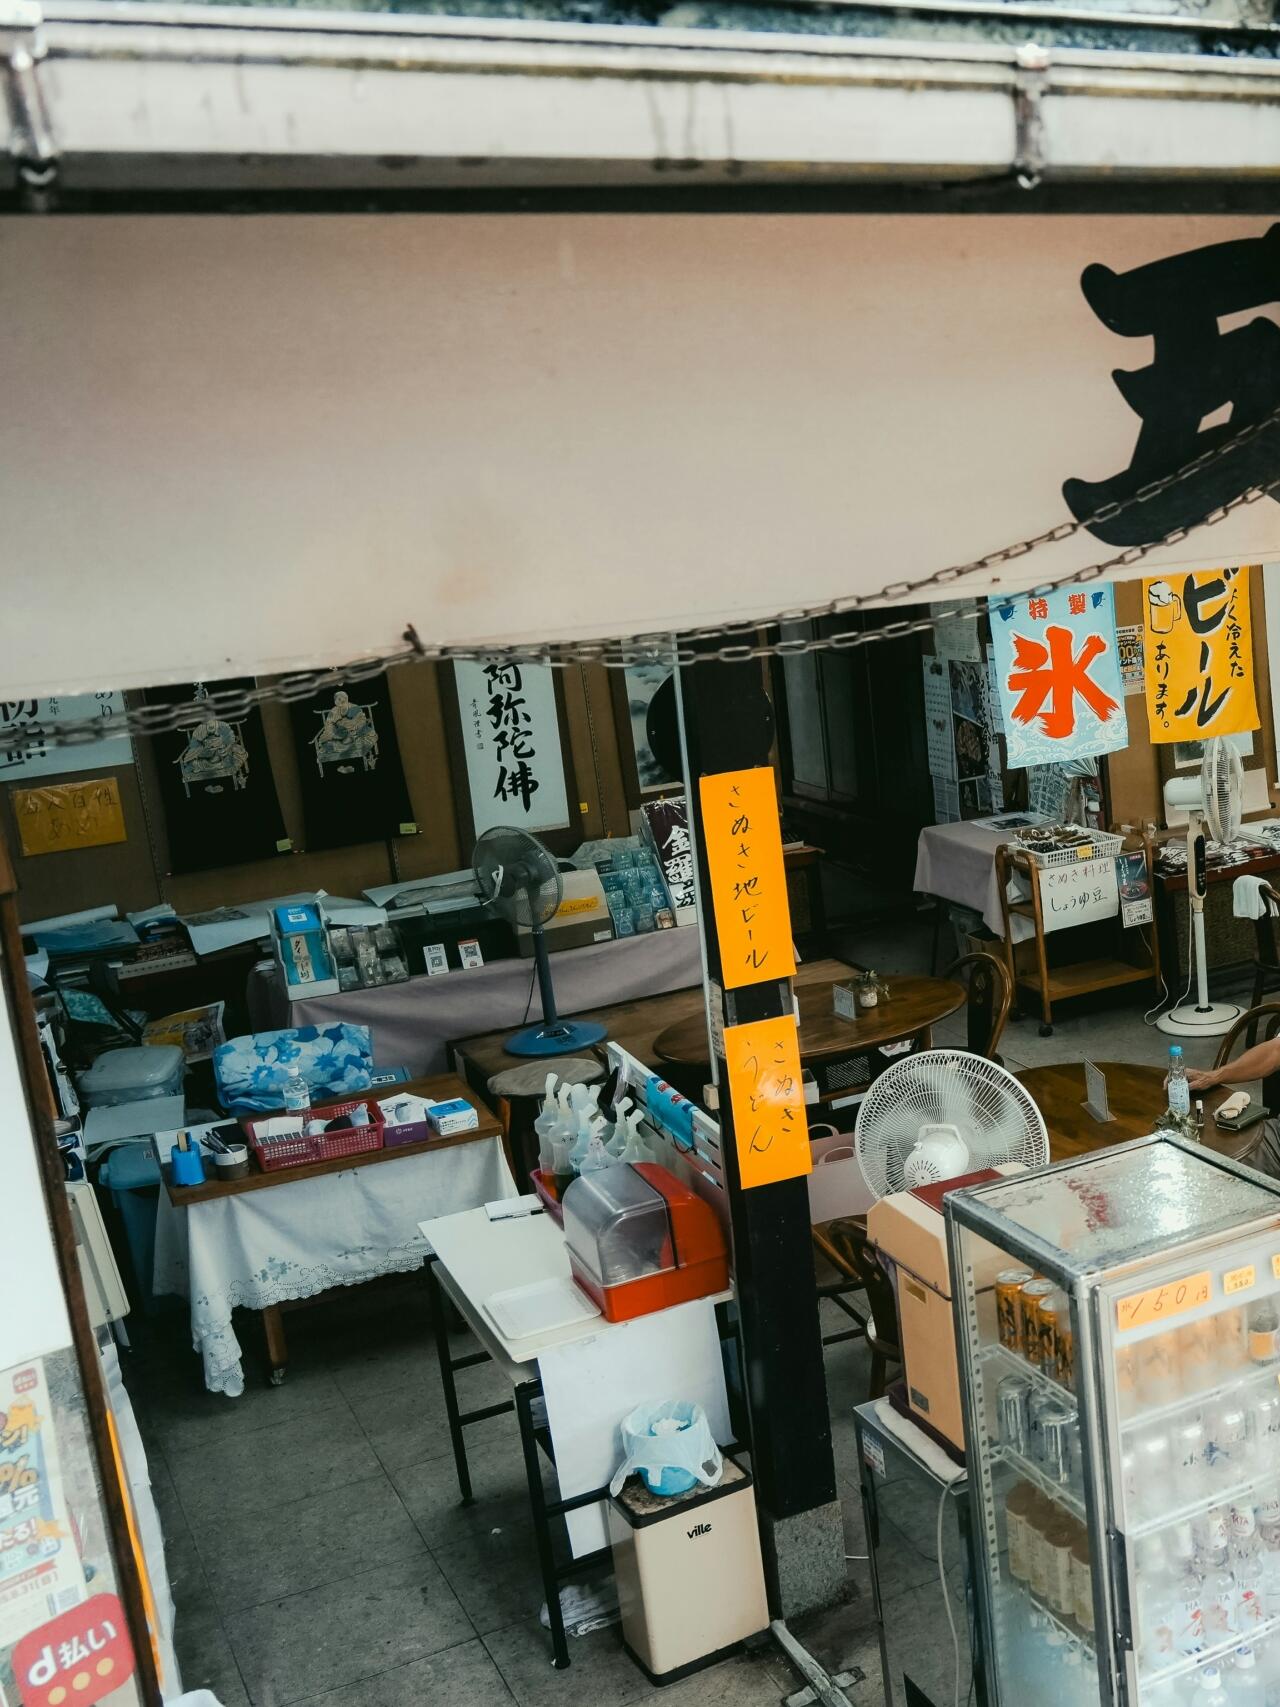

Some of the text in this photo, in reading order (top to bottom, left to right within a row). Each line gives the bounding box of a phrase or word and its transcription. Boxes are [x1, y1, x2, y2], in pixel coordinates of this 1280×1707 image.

[1028, 593, 1087, 621] 特製
[1175, 567, 1240, 727] ビール
[1225, 588, 1245, 679] よく冷えた
[1007, 624, 1120, 739] 氷
[1154, 640, 1170, 729] あります。
[482, 661, 540, 813] 阿弥陀佛
[728, 784, 768, 970] さぬき地ビール
[1050, 886, 1108, 912] しょうゆ豆
[686, 1523, 712, 1539] ville
[27, 1620, 118, 1687] d払い
